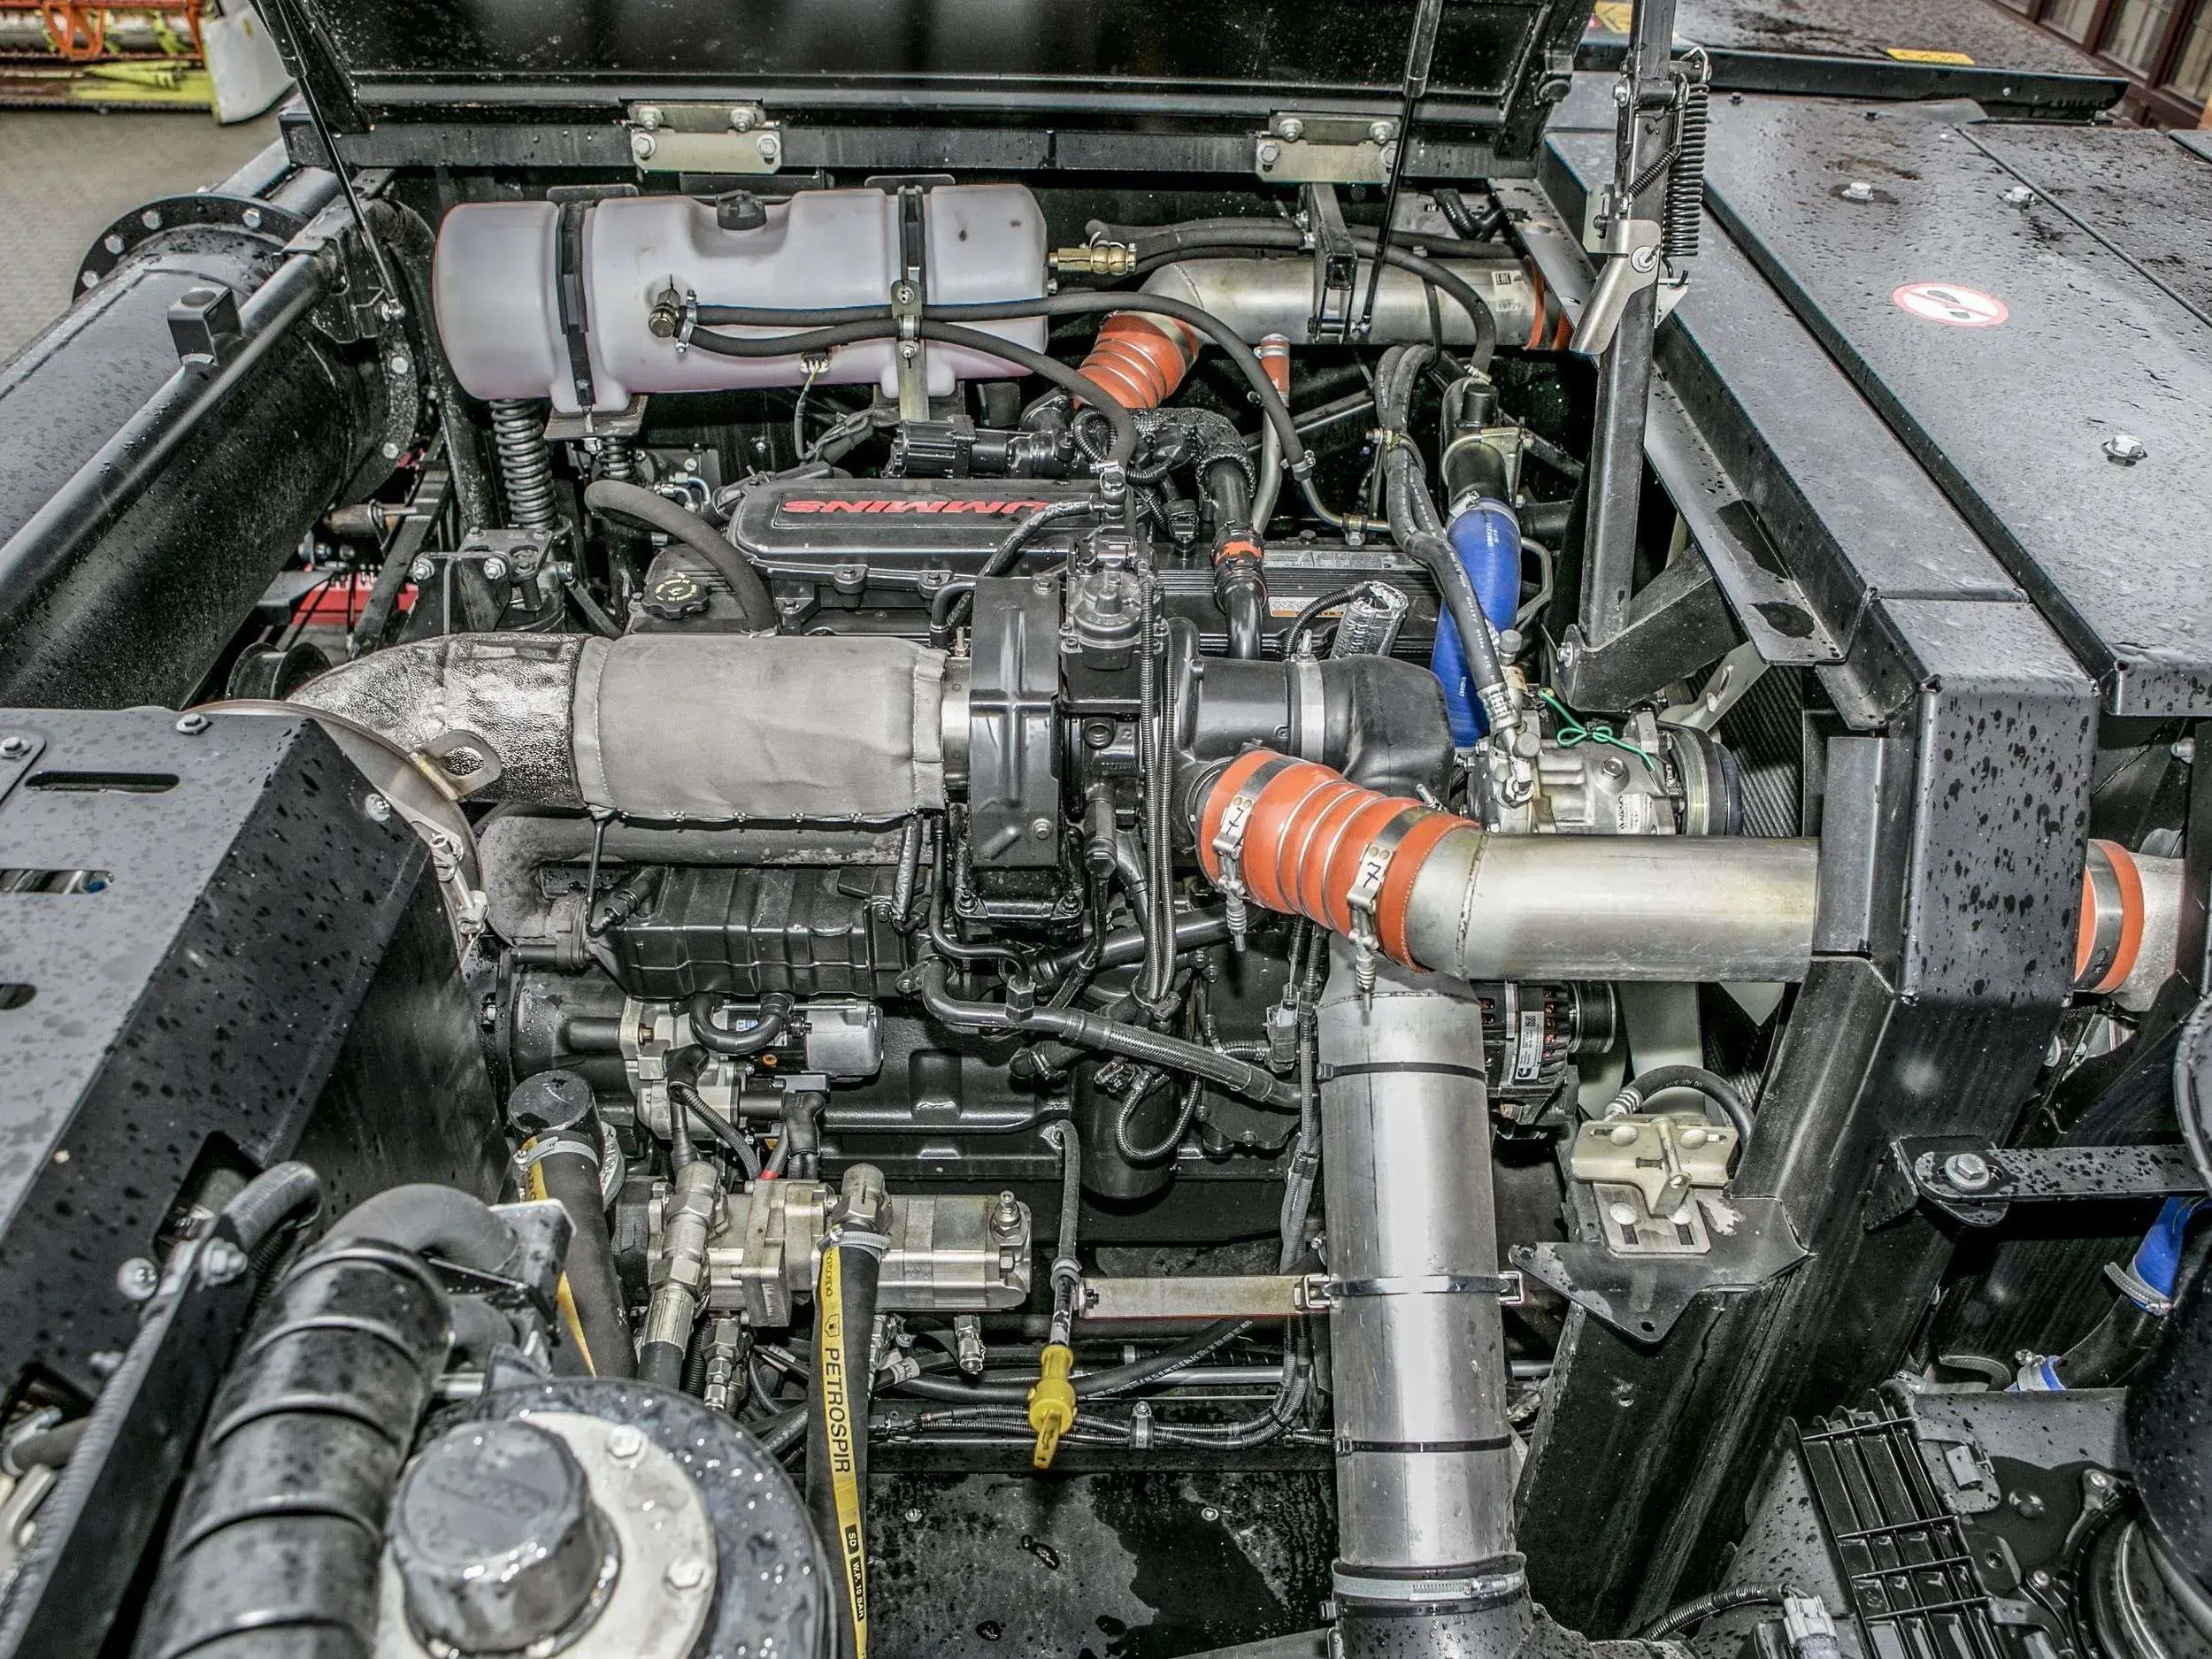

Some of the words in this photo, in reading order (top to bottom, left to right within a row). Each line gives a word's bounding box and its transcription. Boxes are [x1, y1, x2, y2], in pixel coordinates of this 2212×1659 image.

[781, 500, 1048, 514] UMMINS
[1226, 806, 1243, 835] 7
[1363, 861, 1381, 888] 7
[825, 1348, 850, 1473] PETROSPIR
[848, 1532, 856, 1547] SD
[852, 1562, 861, 1582] W.P.
[855, 1585, 862, 1594] 10
